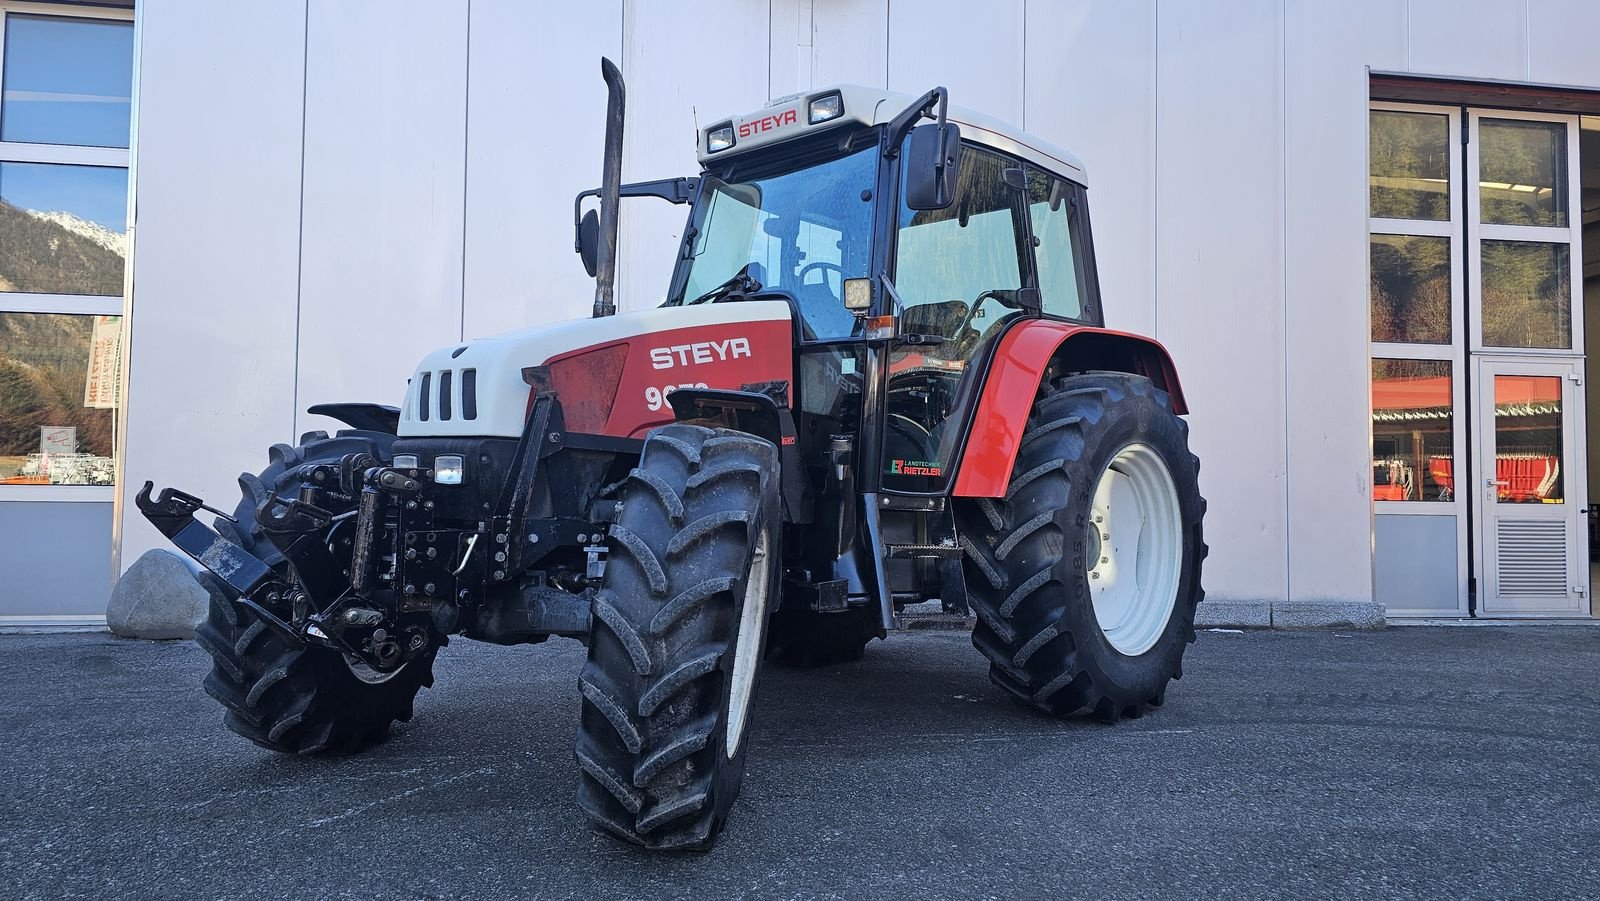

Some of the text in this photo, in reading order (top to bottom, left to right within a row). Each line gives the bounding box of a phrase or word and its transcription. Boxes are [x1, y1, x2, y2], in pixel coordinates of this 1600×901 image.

[738, 109, 797, 138] STEYR
[650, 337, 751, 370] STEYR
[645, 382, 709, 412] 90
[904, 460, 941, 468] LANDTECHNIK
[904, 466, 941, 476] RIETZLER
